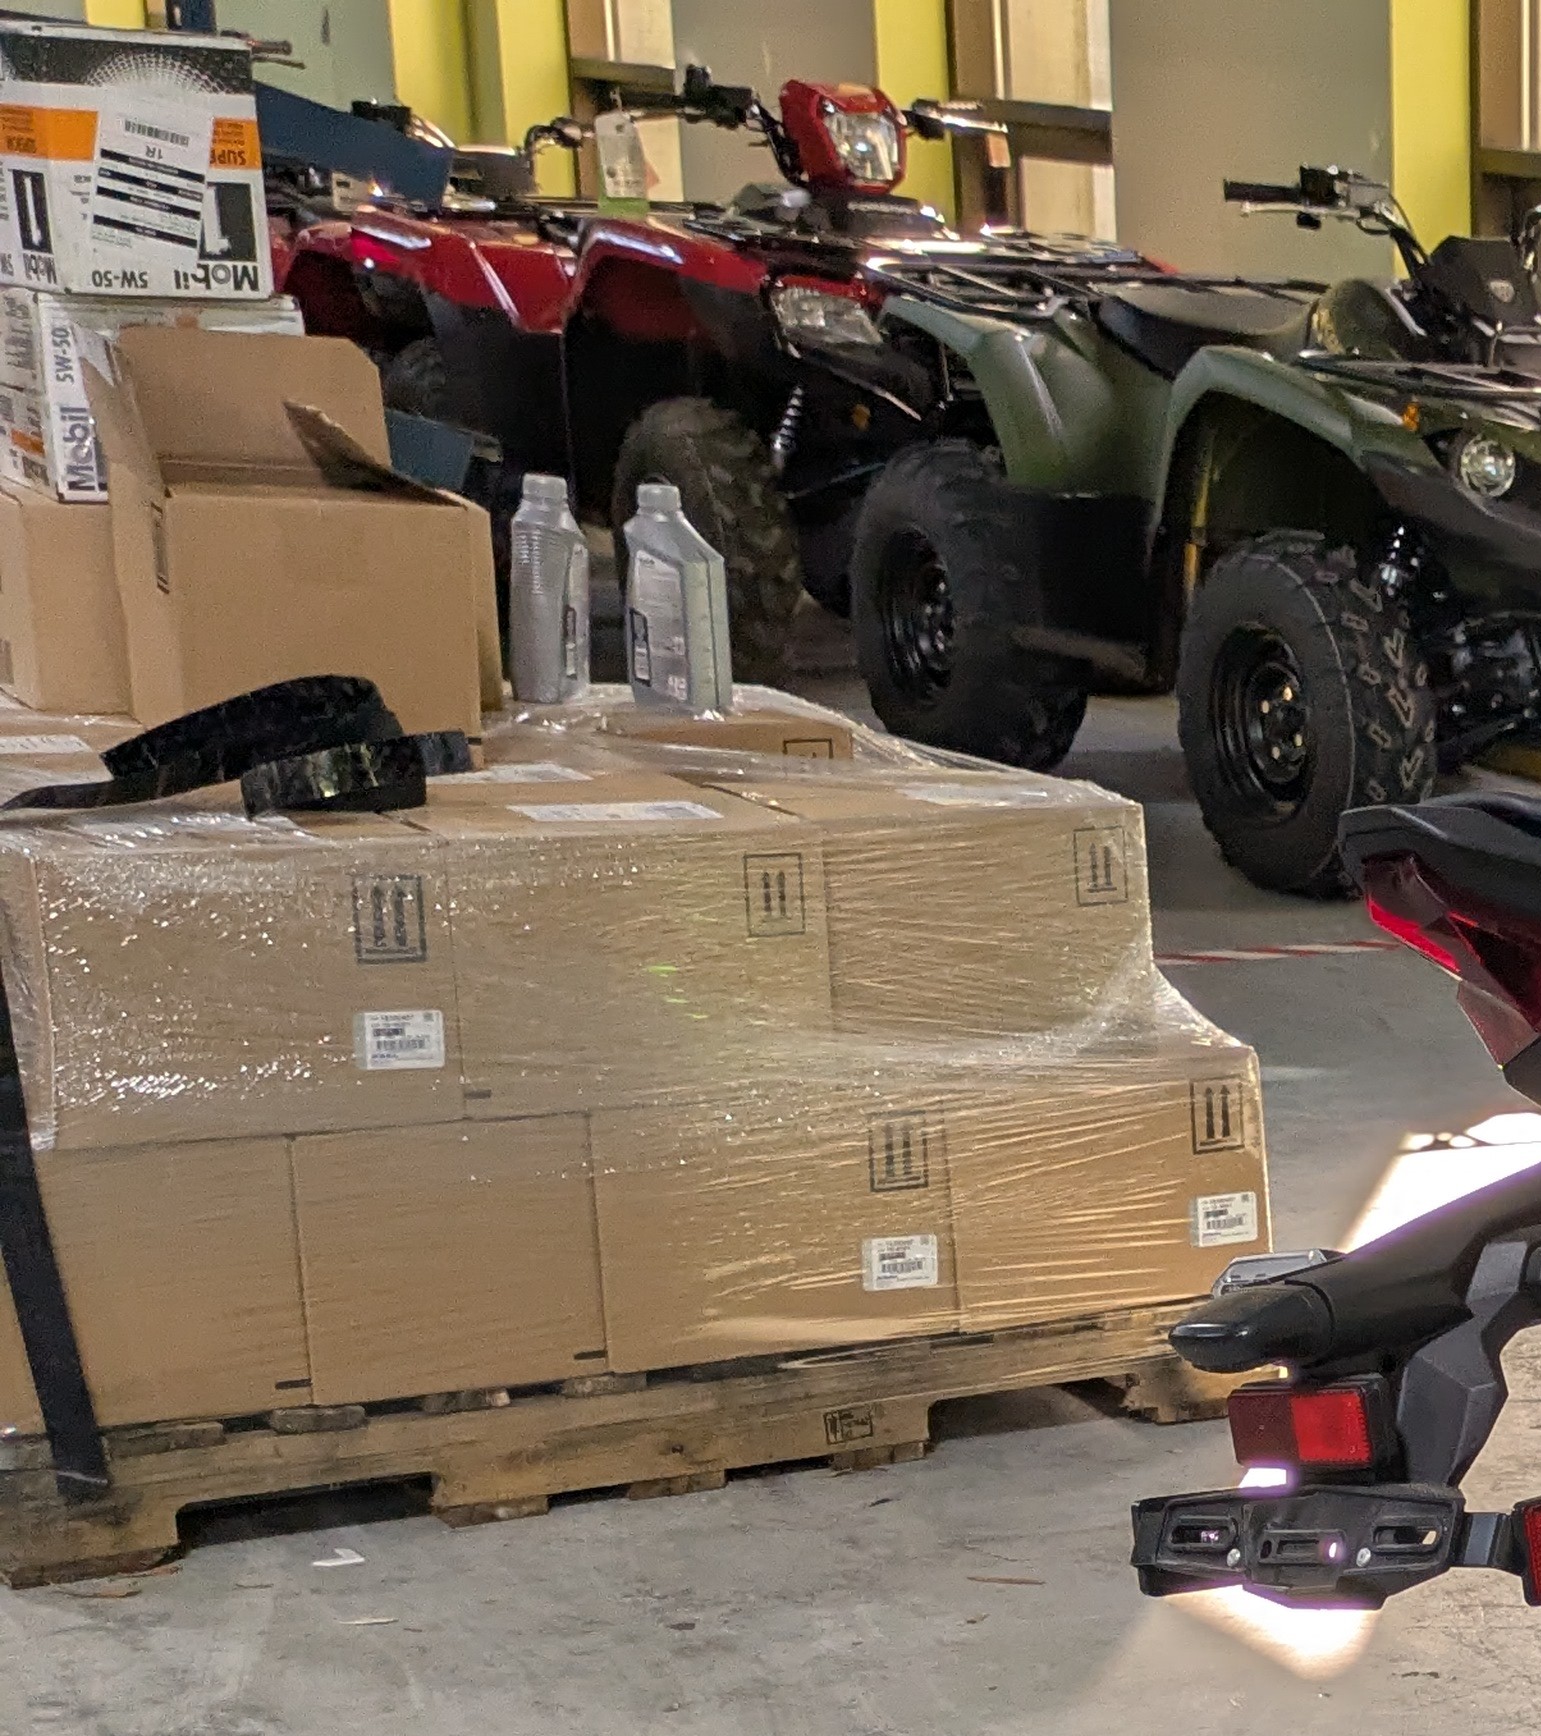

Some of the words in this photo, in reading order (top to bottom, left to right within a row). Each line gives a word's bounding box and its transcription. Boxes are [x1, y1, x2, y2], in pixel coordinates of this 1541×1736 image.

[92, 269, 149, 289] 5W-50
[173, 264, 260, 292] Mobil
[52, 326, 75, 385] 5W-50
[59, 406, 95, 492] Mobil
